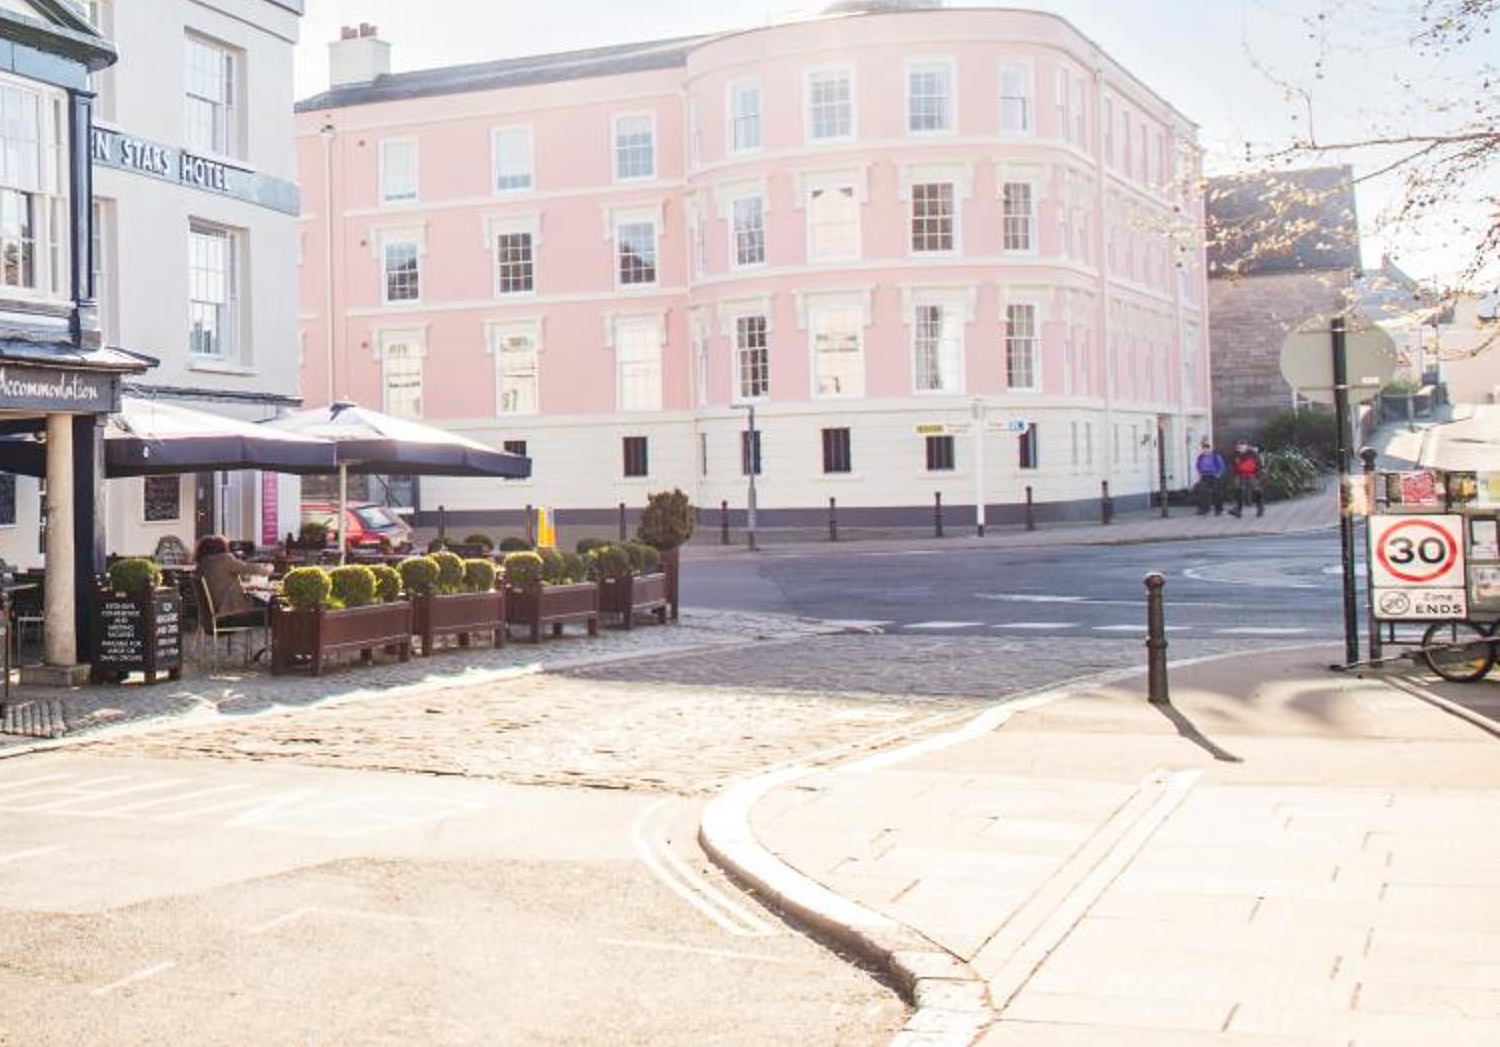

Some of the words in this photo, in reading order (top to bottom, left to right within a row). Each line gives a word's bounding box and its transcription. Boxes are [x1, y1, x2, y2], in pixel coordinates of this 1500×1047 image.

[120, 137, 172, 174] STARS
[181, 152, 230, 192] HOTEL
[1388, 536, 1446, 565] 30
[1414, 603, 1463, 615] ENDS
